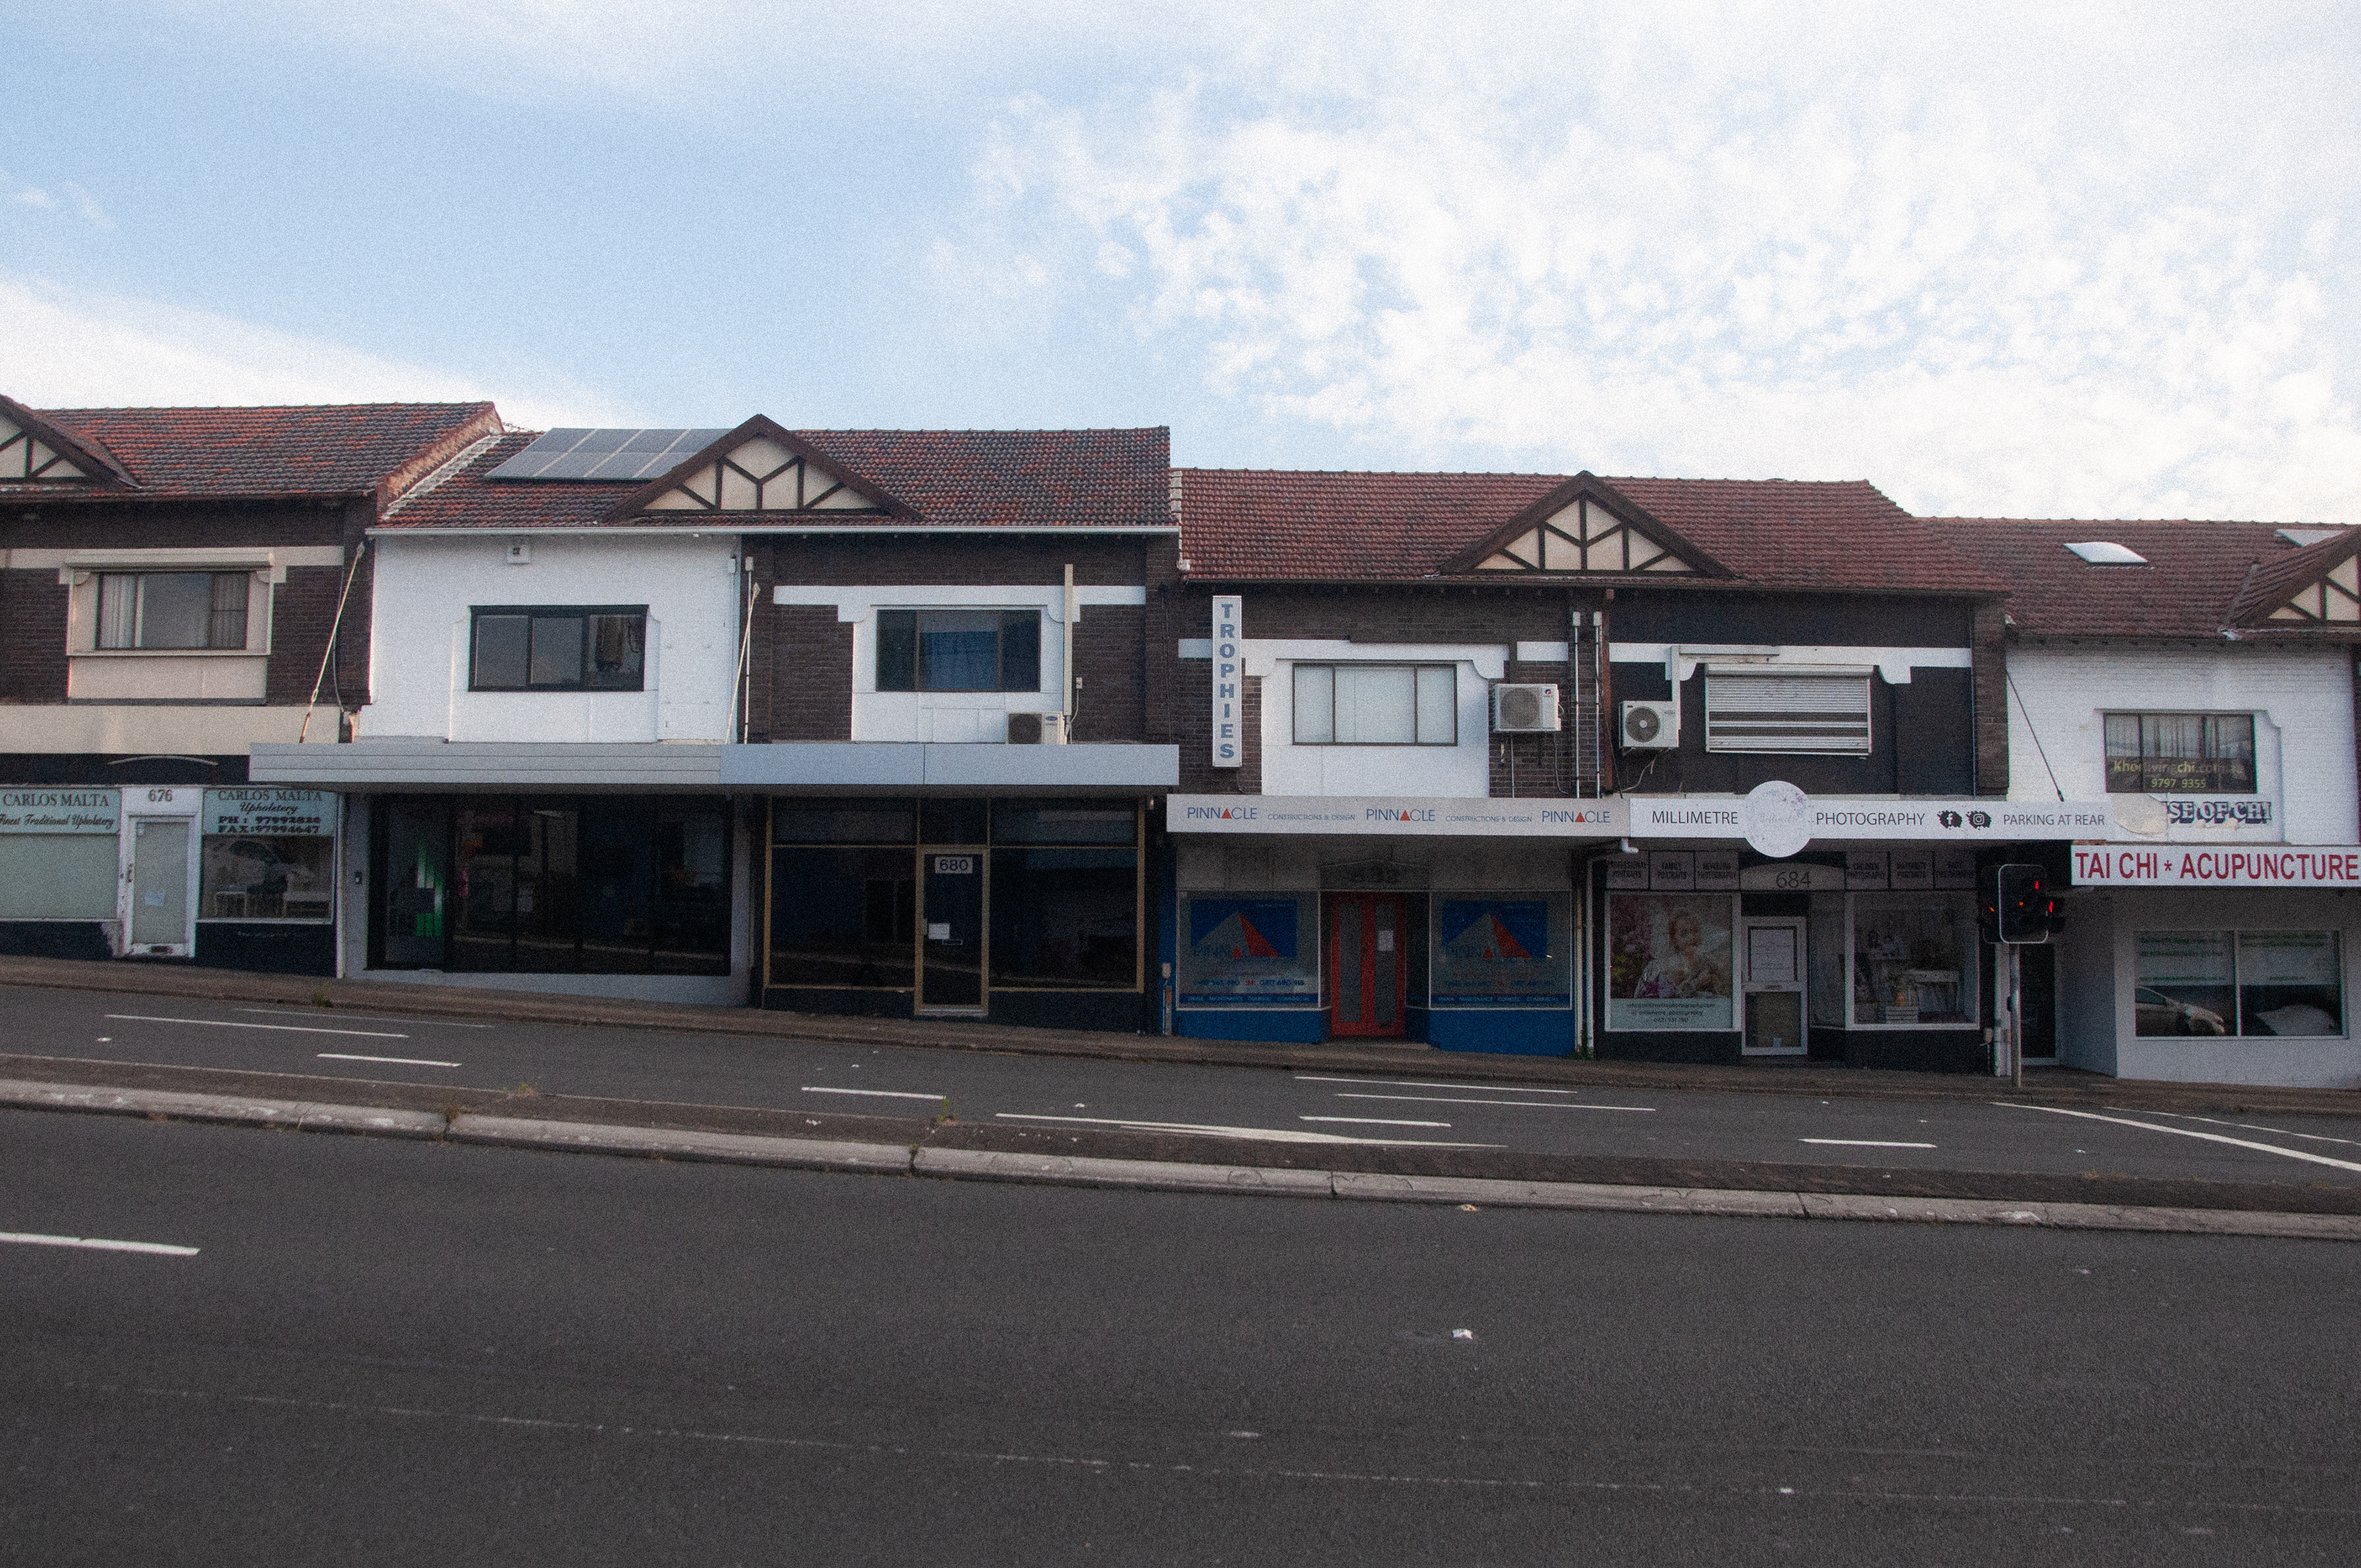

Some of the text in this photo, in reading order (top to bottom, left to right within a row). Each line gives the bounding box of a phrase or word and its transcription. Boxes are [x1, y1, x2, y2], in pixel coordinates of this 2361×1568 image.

[1219, 603, 1235, 759] TROPHIES
[2151, 778, 2207, 789] 9797 9355
[3, 793, 109, 807] CARLOS MALTA
[148, 789, 173, 802] 676
[218, 791, 323, 801] CARLOS MALTA
[240, 801, 299, 815] Upholstery
[1187, 807, 1257, 820] PINNACLE
[2196, 801, 2230, 824] OF
[2230, 801, 2272, 825] CHI
[218, 815, 239, 824] PH
[1366, 808, 1436, 822] PINNACLE
[1541, 810, 1611, 823] PINNACLE
[1652, 811, 1925, 825] MILLIMETRE PHOTOGRAPHY
[2003, 814, 2105, 825] PARKING AT REAR
[25, 814, 71, 825] Traditional
[72, 814, 115, 830] Upholstery
[939, 858, 969, 871] 680
[1661, 861, 1682, 870] FAMILY
[2075, 852, 2360, 880] TAI CHI ACUPUNCTURE
[1775, 871, 1812, 889] 684
